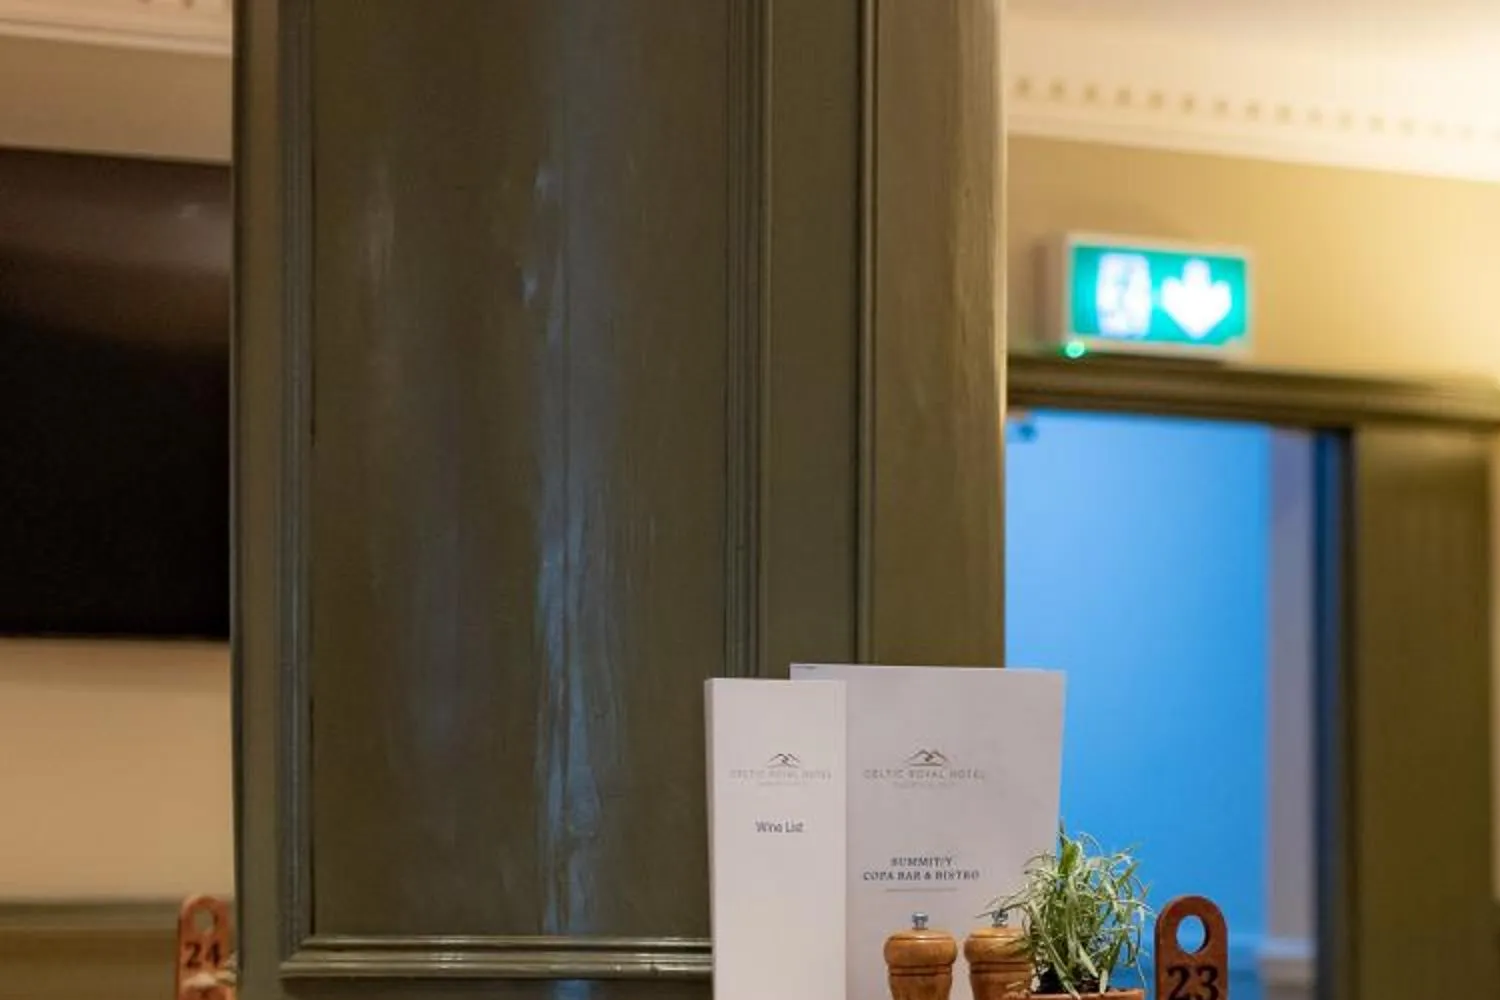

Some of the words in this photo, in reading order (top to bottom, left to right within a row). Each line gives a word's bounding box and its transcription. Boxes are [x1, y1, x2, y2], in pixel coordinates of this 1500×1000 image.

[863, 769, 904, 780] CELTIC
[908, 769, 945, 780] ROYAL
[949, 769, 986, 780] HOTEL
[755, 820, 784, 834] Wine
[785, 820, 804, 834] List
[897, 870, 922, 881] BAR
[934, 870, 980, 881] BISTRO
[184, 940, 222, 969] 24
